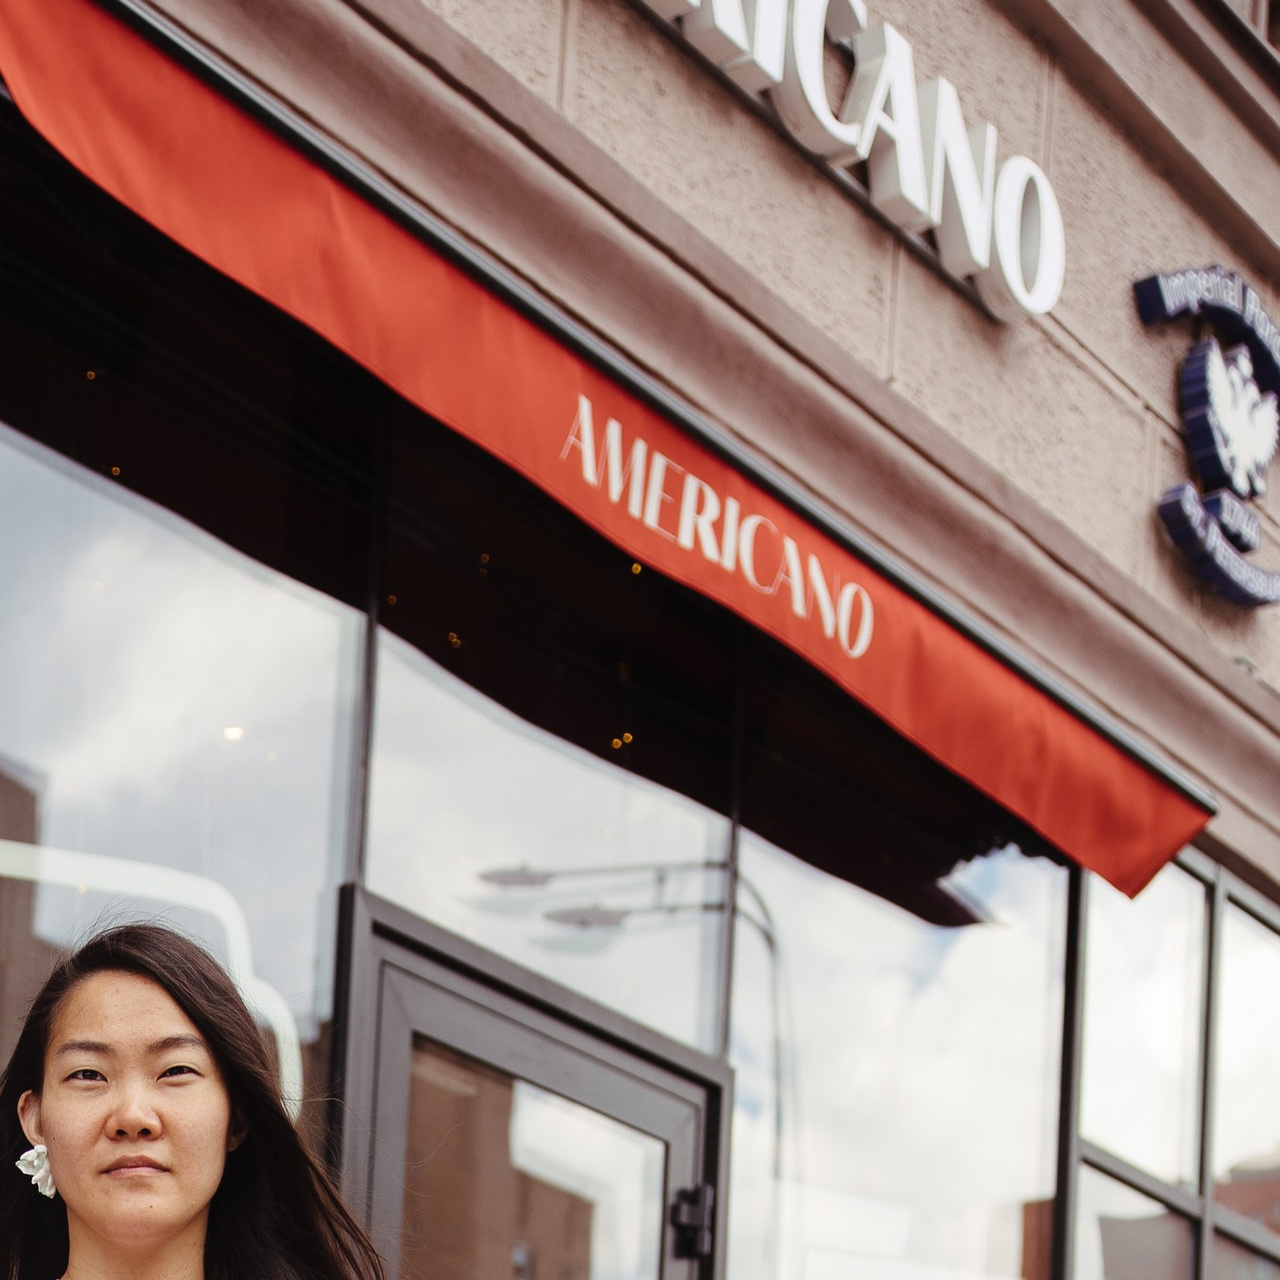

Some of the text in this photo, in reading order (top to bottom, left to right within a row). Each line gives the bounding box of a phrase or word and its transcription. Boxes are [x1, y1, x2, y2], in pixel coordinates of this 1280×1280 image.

[680, 0, 1066, 314] ICANO
[1157, 266, 1243, 315] Imperial
[559, 393, 875, 660] AMERICANO
